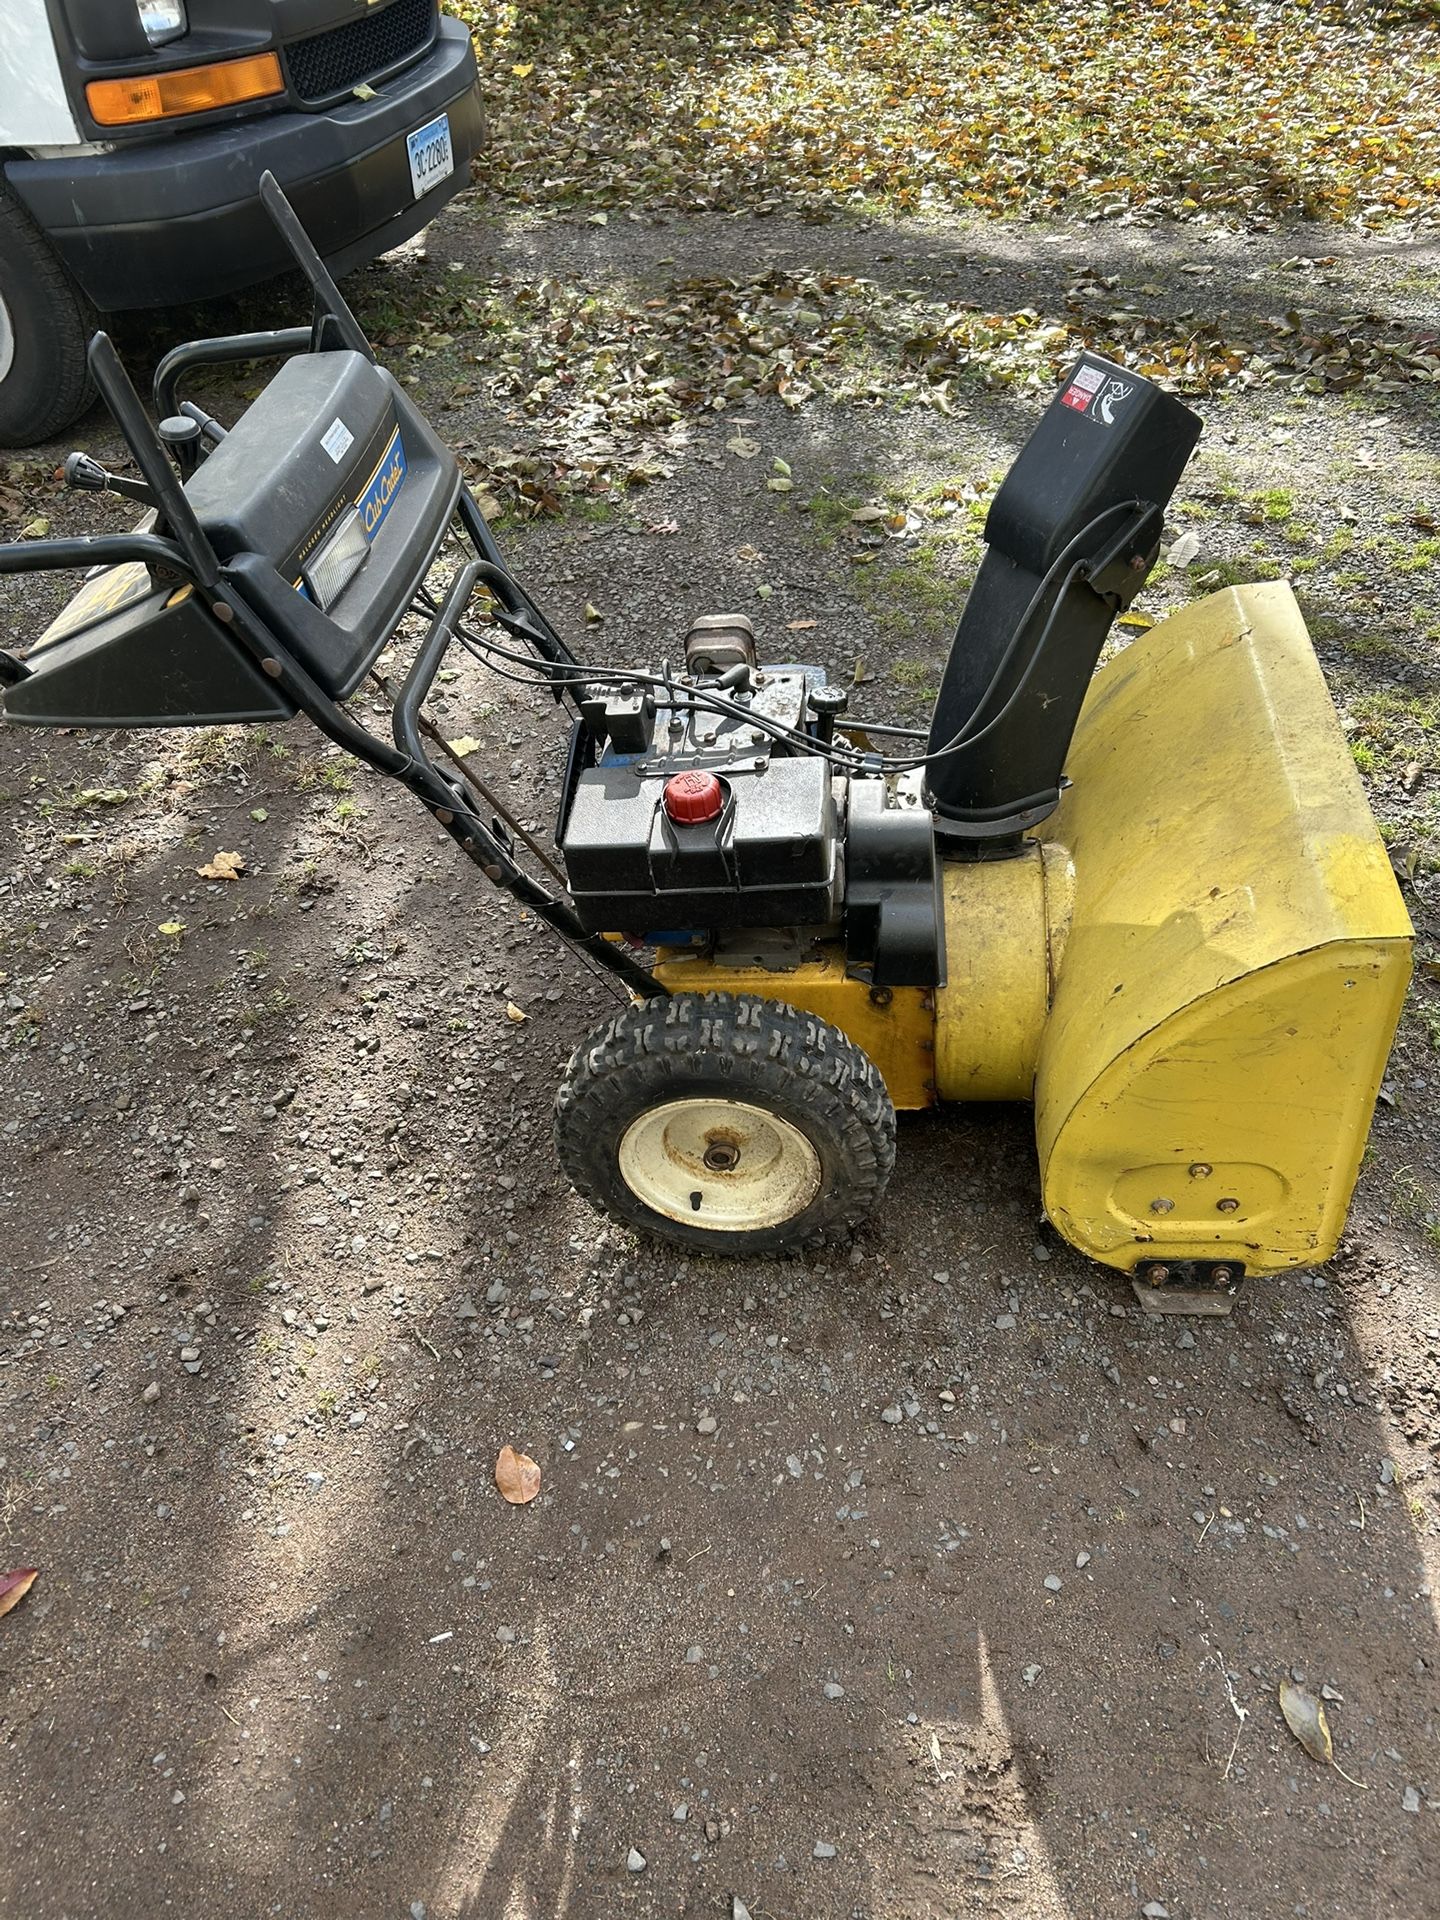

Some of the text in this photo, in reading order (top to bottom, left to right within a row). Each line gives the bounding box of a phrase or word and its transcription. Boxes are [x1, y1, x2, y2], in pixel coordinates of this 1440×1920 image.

[1068, 386, 1093, 402] DANGER
[365, 451, 403, 532] Cub Cadet
[321, 494, 346, 529] HEADLIGHT
